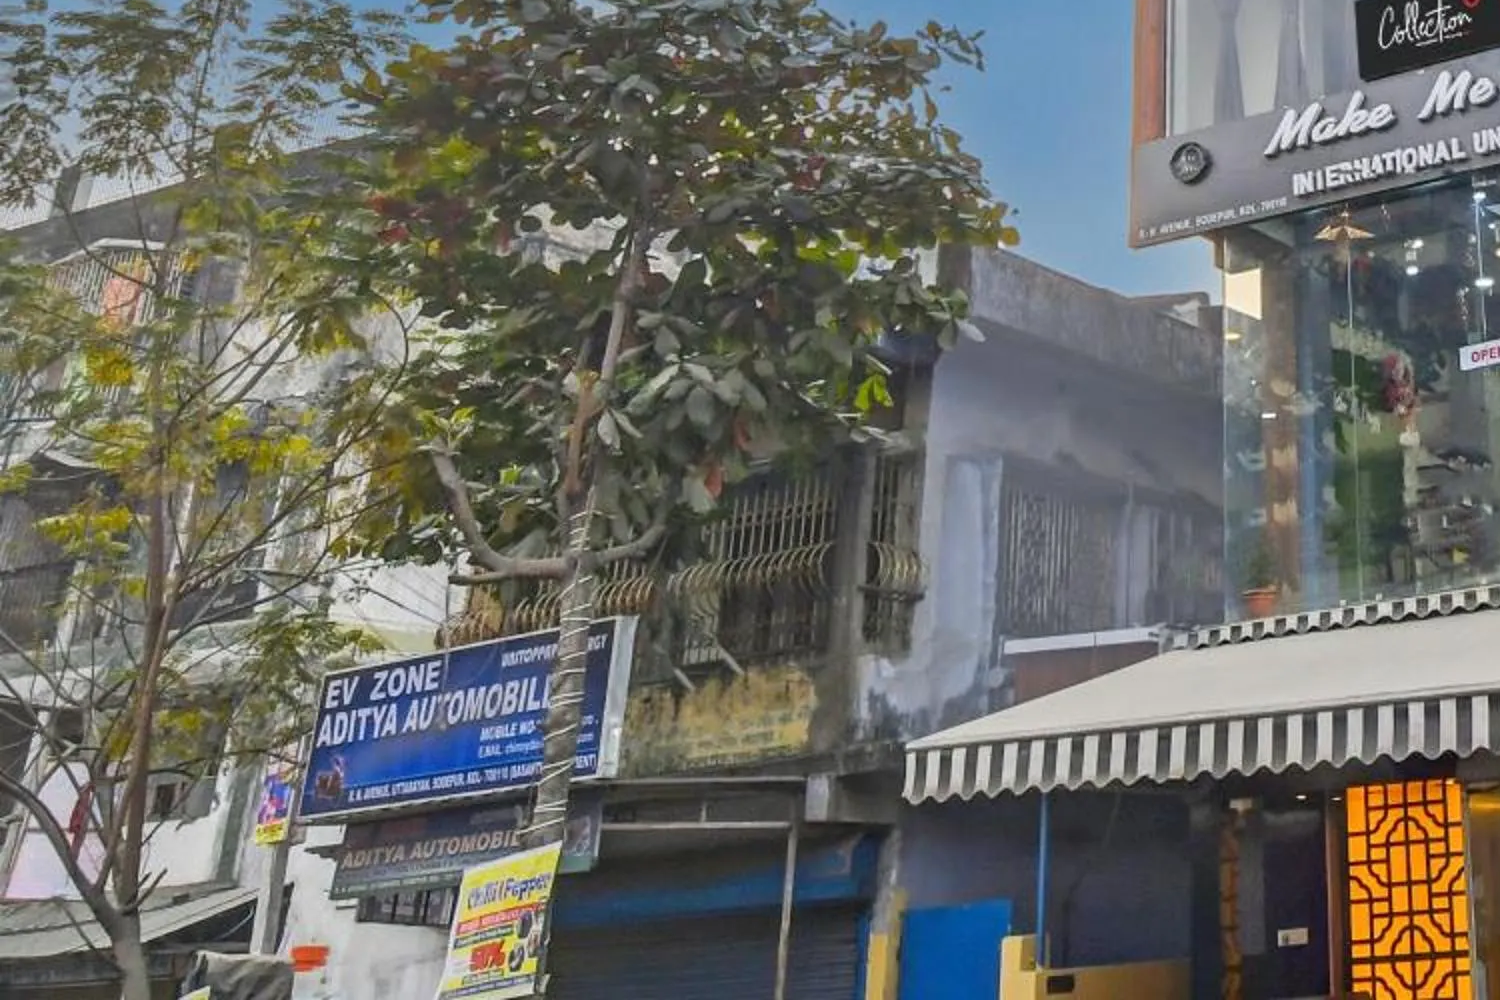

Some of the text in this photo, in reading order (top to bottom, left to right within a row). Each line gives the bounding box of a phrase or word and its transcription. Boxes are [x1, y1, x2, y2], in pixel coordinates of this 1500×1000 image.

[1263, 90, 1397, 156] Make
[325, 660, 443, 709] EV ZONE
[316, 701, 399, 748] ADITYA
[341, 832, 521, 870] ADITYA AUTOMOBIL
